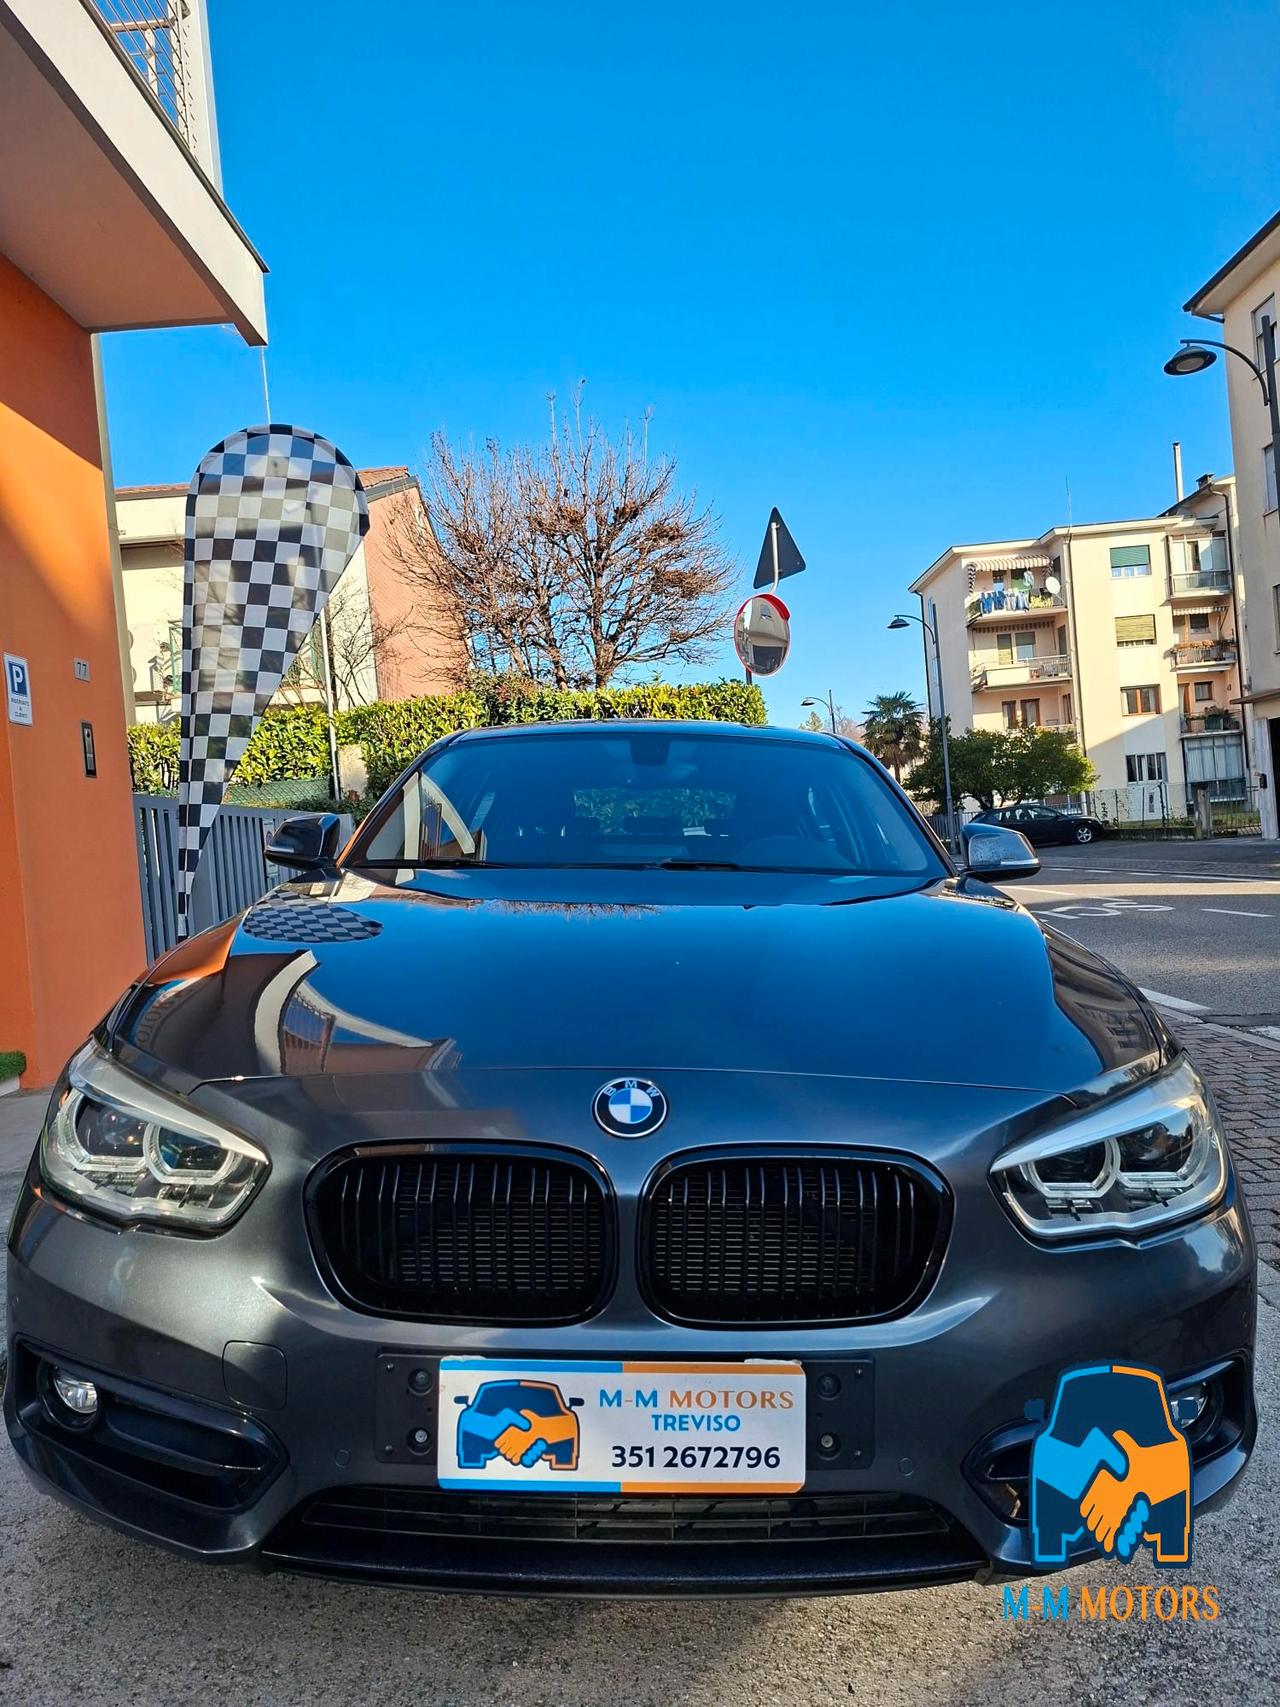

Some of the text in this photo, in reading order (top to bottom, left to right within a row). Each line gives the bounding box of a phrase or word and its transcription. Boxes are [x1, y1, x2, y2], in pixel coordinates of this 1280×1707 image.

[12, 665, 24, 691] P
[603, 1079, 660, 1098] BMW
[599, 1389, 794, 1409] M-M MOTORS
[651, 1414, 741, 1432] TREVISO
[611, 1446, 781, 1469] 351 2672796
